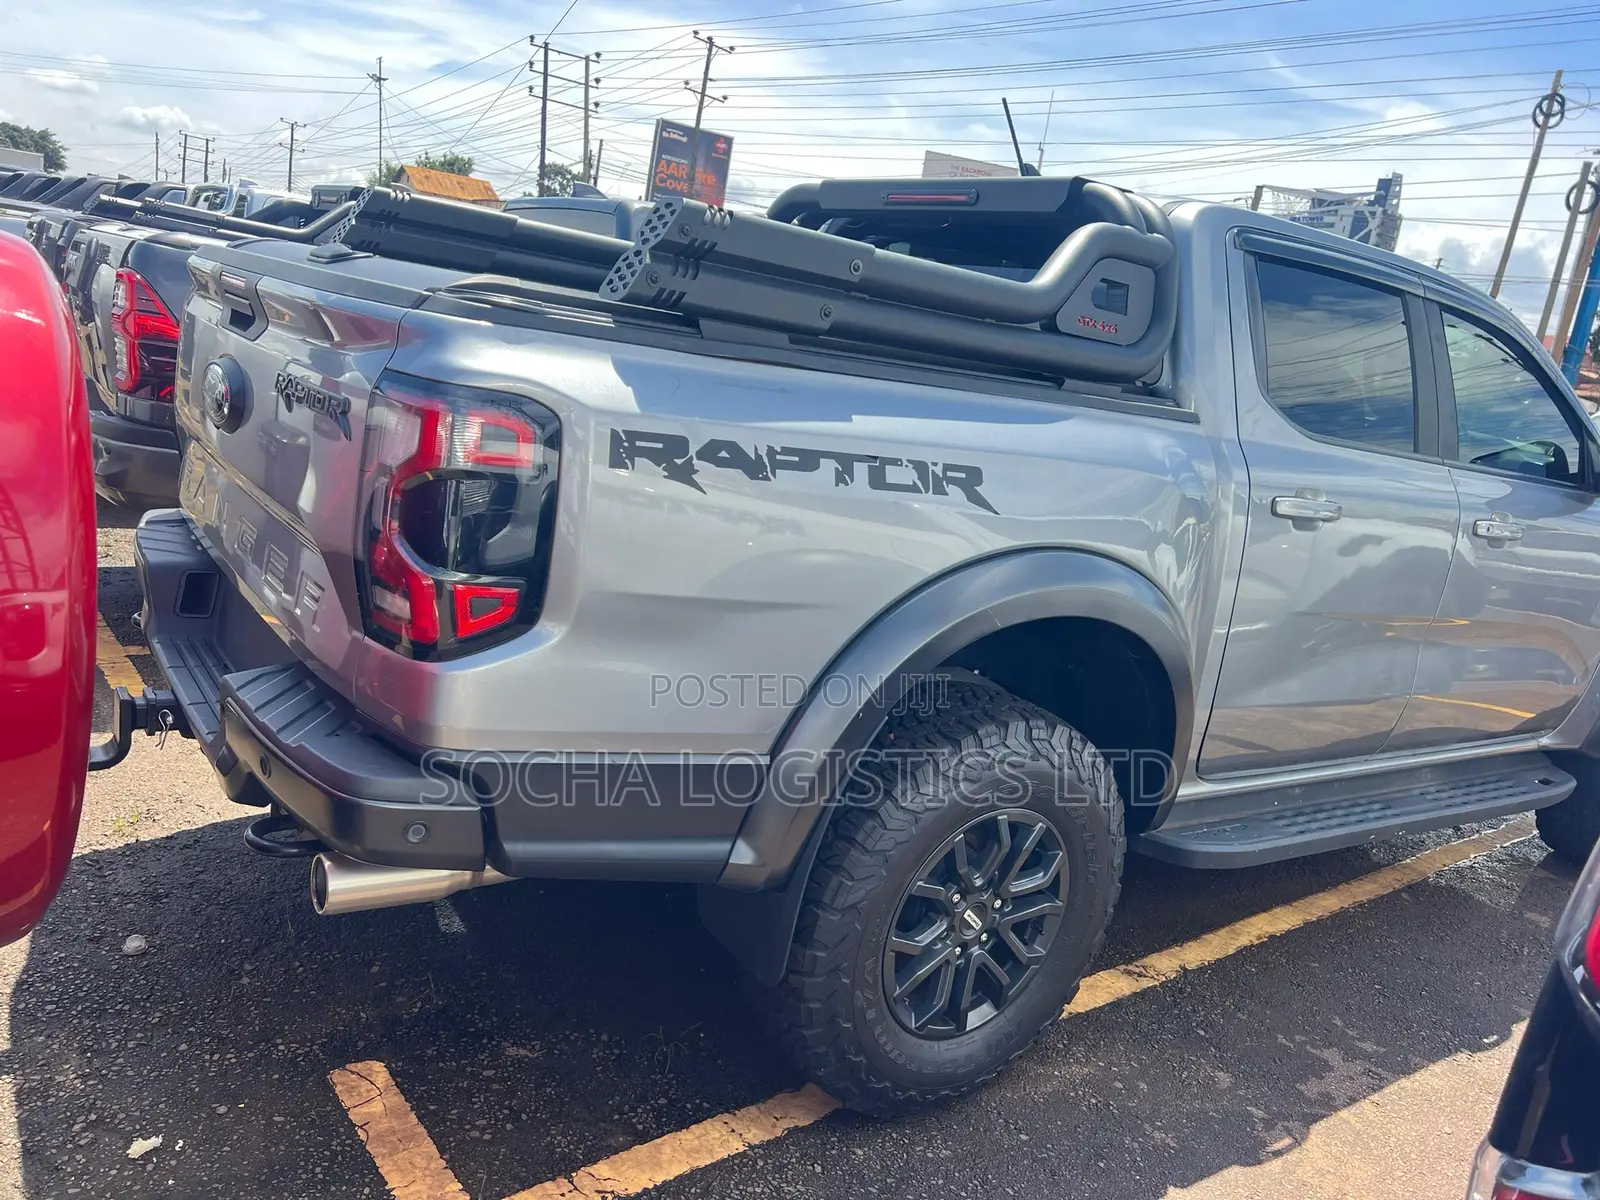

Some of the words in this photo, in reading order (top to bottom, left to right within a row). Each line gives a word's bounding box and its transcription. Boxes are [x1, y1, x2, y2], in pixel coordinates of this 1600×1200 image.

[657, 160, 688, 179] AAR
[274, 369, 352, 442] RAPTOR
[609, 427, 1000, 516] RAPTOR
